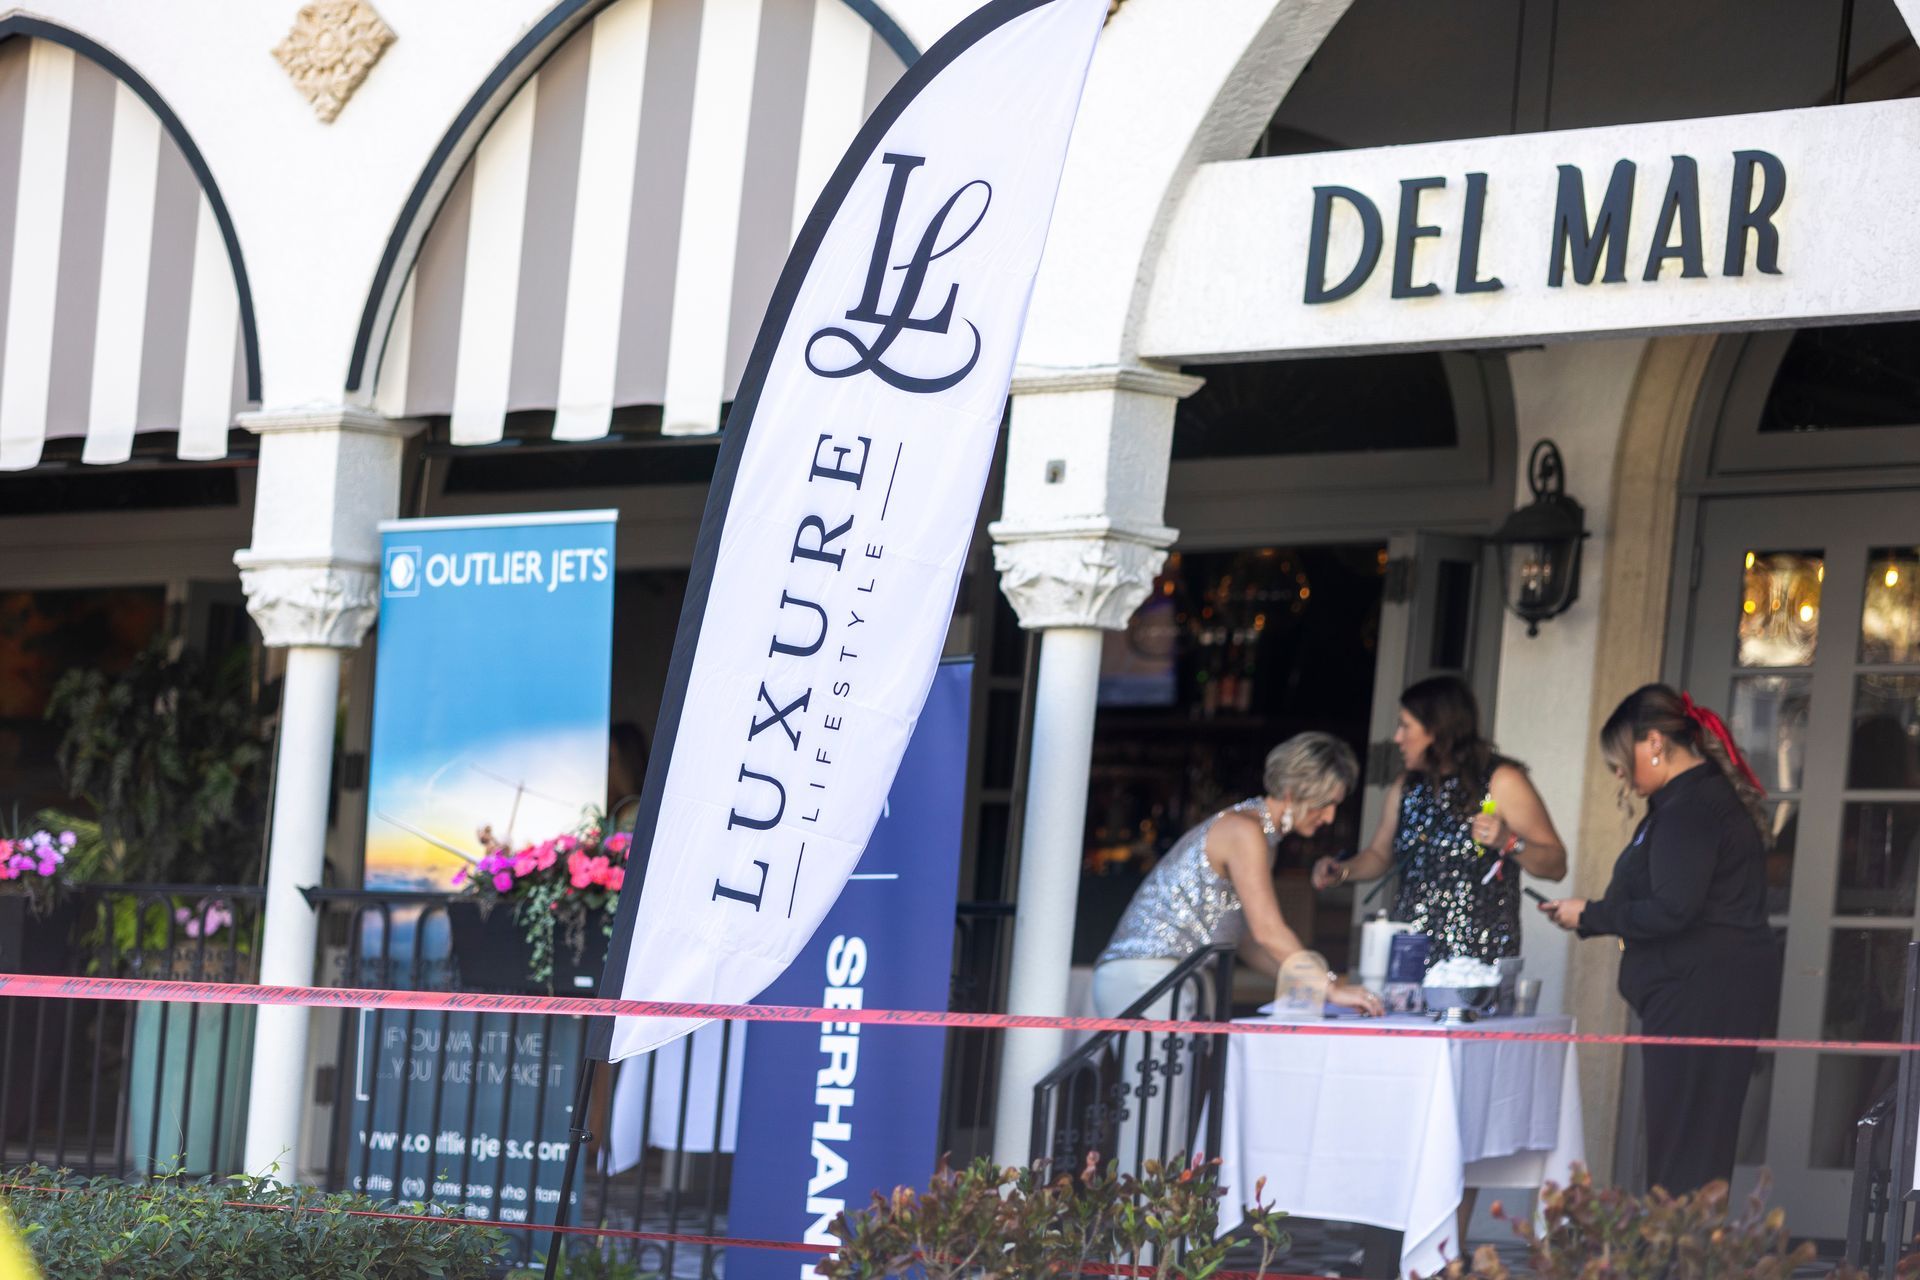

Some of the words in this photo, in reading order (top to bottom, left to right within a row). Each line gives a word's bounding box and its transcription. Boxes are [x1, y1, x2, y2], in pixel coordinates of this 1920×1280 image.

[1304, 173, 1504, 305] DEL
[1548, 150, 1787, 288] MAR
[425, 550, 543, 587] OUTLIER
[547, 547, 608, 593] JETS
[712, 433, 872, 912] LUXURE
[802, 542, 883, 823] LIFESTYLE
[441, 995, 476, 1008] NO
[474, 996, 543, 1010] ENTRY
[546, 998, 641, 1014] WITHOUT
[801, 934, 867, 1280] SERHAN
